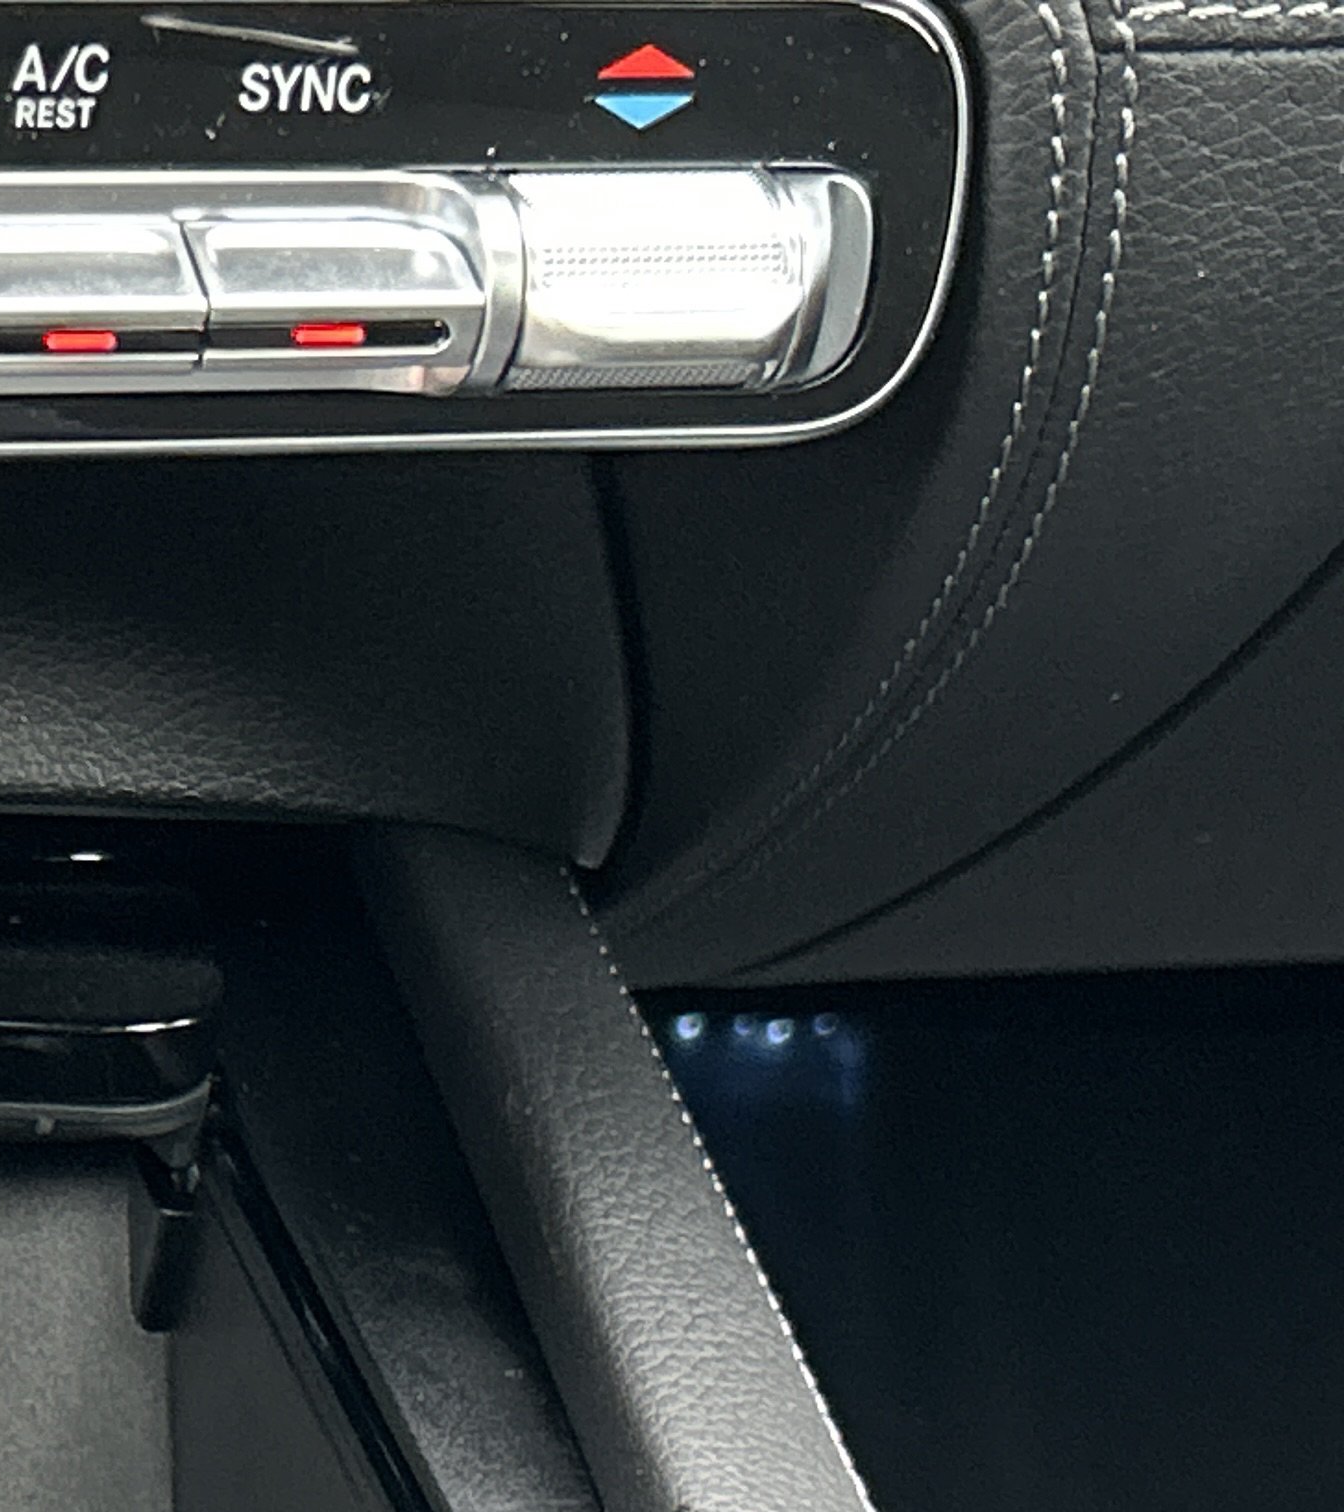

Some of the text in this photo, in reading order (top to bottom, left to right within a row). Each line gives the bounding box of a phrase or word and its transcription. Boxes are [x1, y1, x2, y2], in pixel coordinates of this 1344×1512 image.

[13, 43, 109, 93] A/C
[238, 63, 372, 114] SYNC
[16, 97, 96, 129] REST
